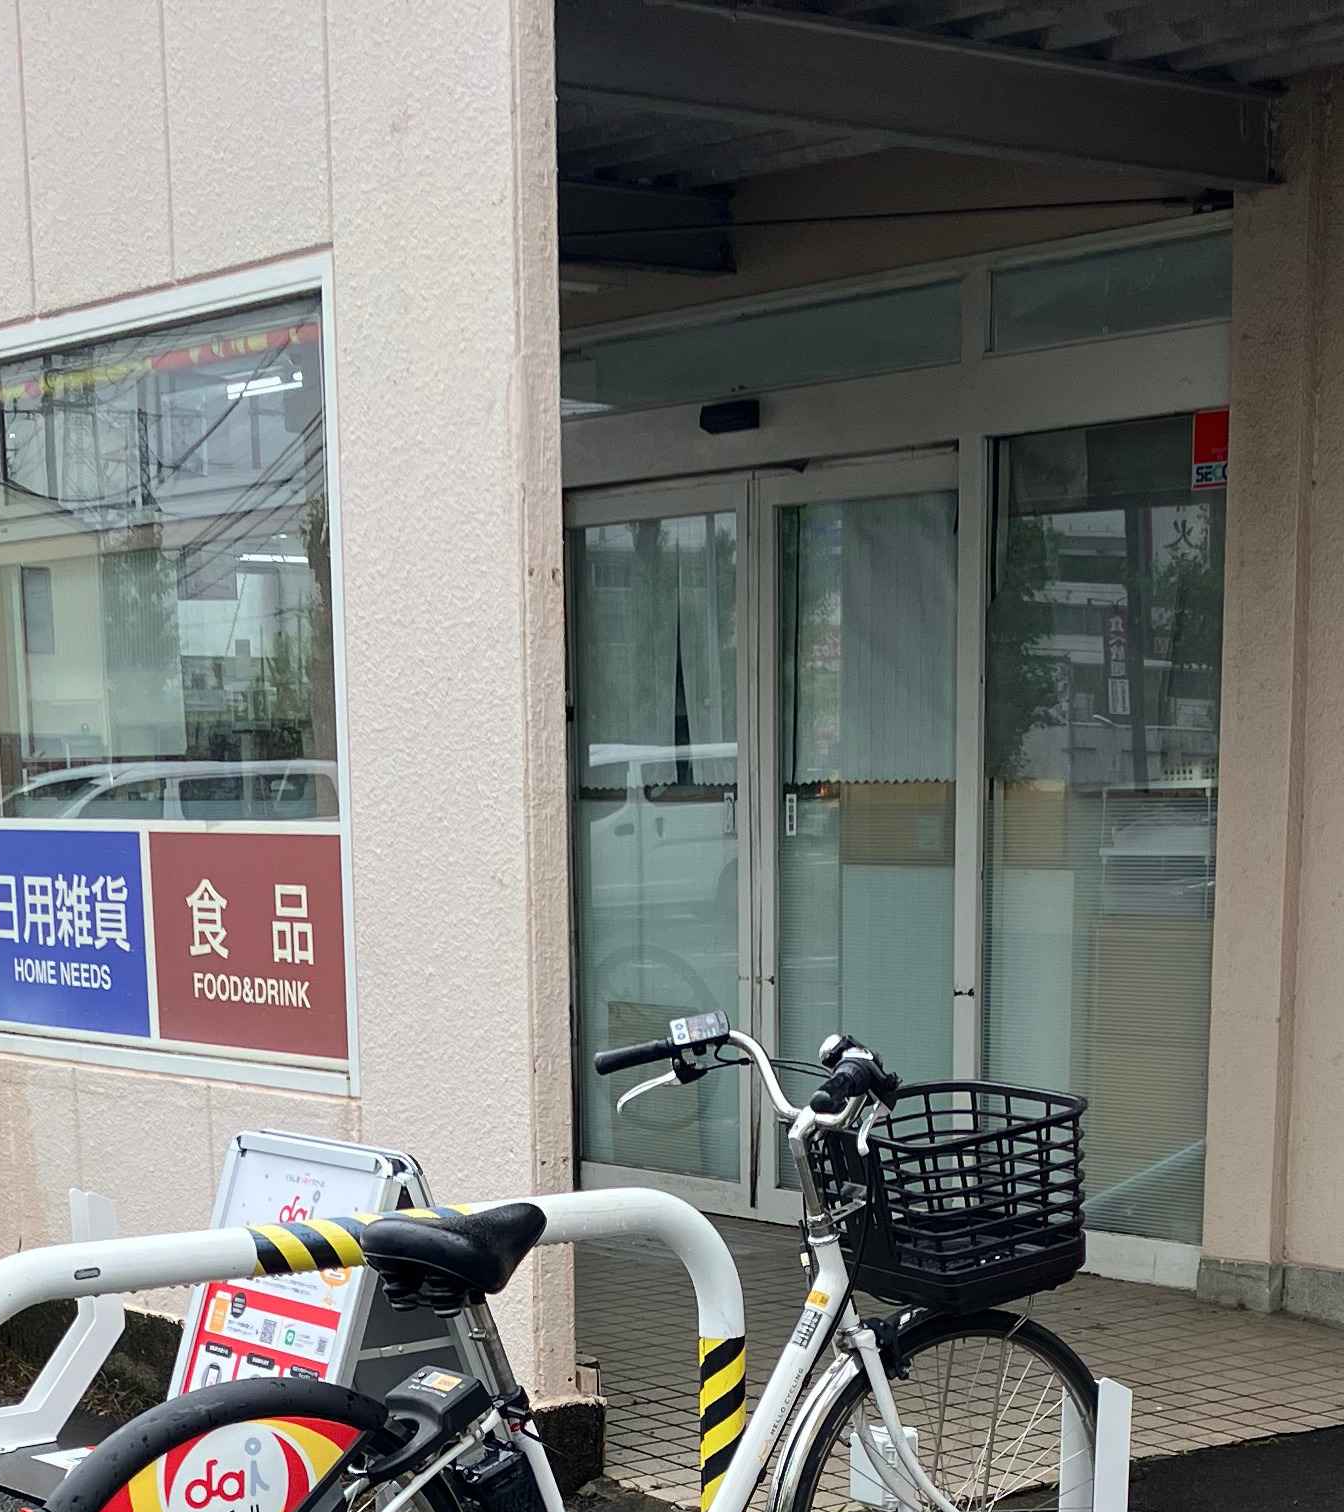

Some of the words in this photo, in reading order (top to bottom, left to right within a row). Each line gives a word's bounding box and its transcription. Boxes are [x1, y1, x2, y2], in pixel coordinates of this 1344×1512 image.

[13, 957, 57, 986] HOME
[59, 961, 112, 990] NEEDS
[192, 971, 312, 1009] FOOD&DRINK
